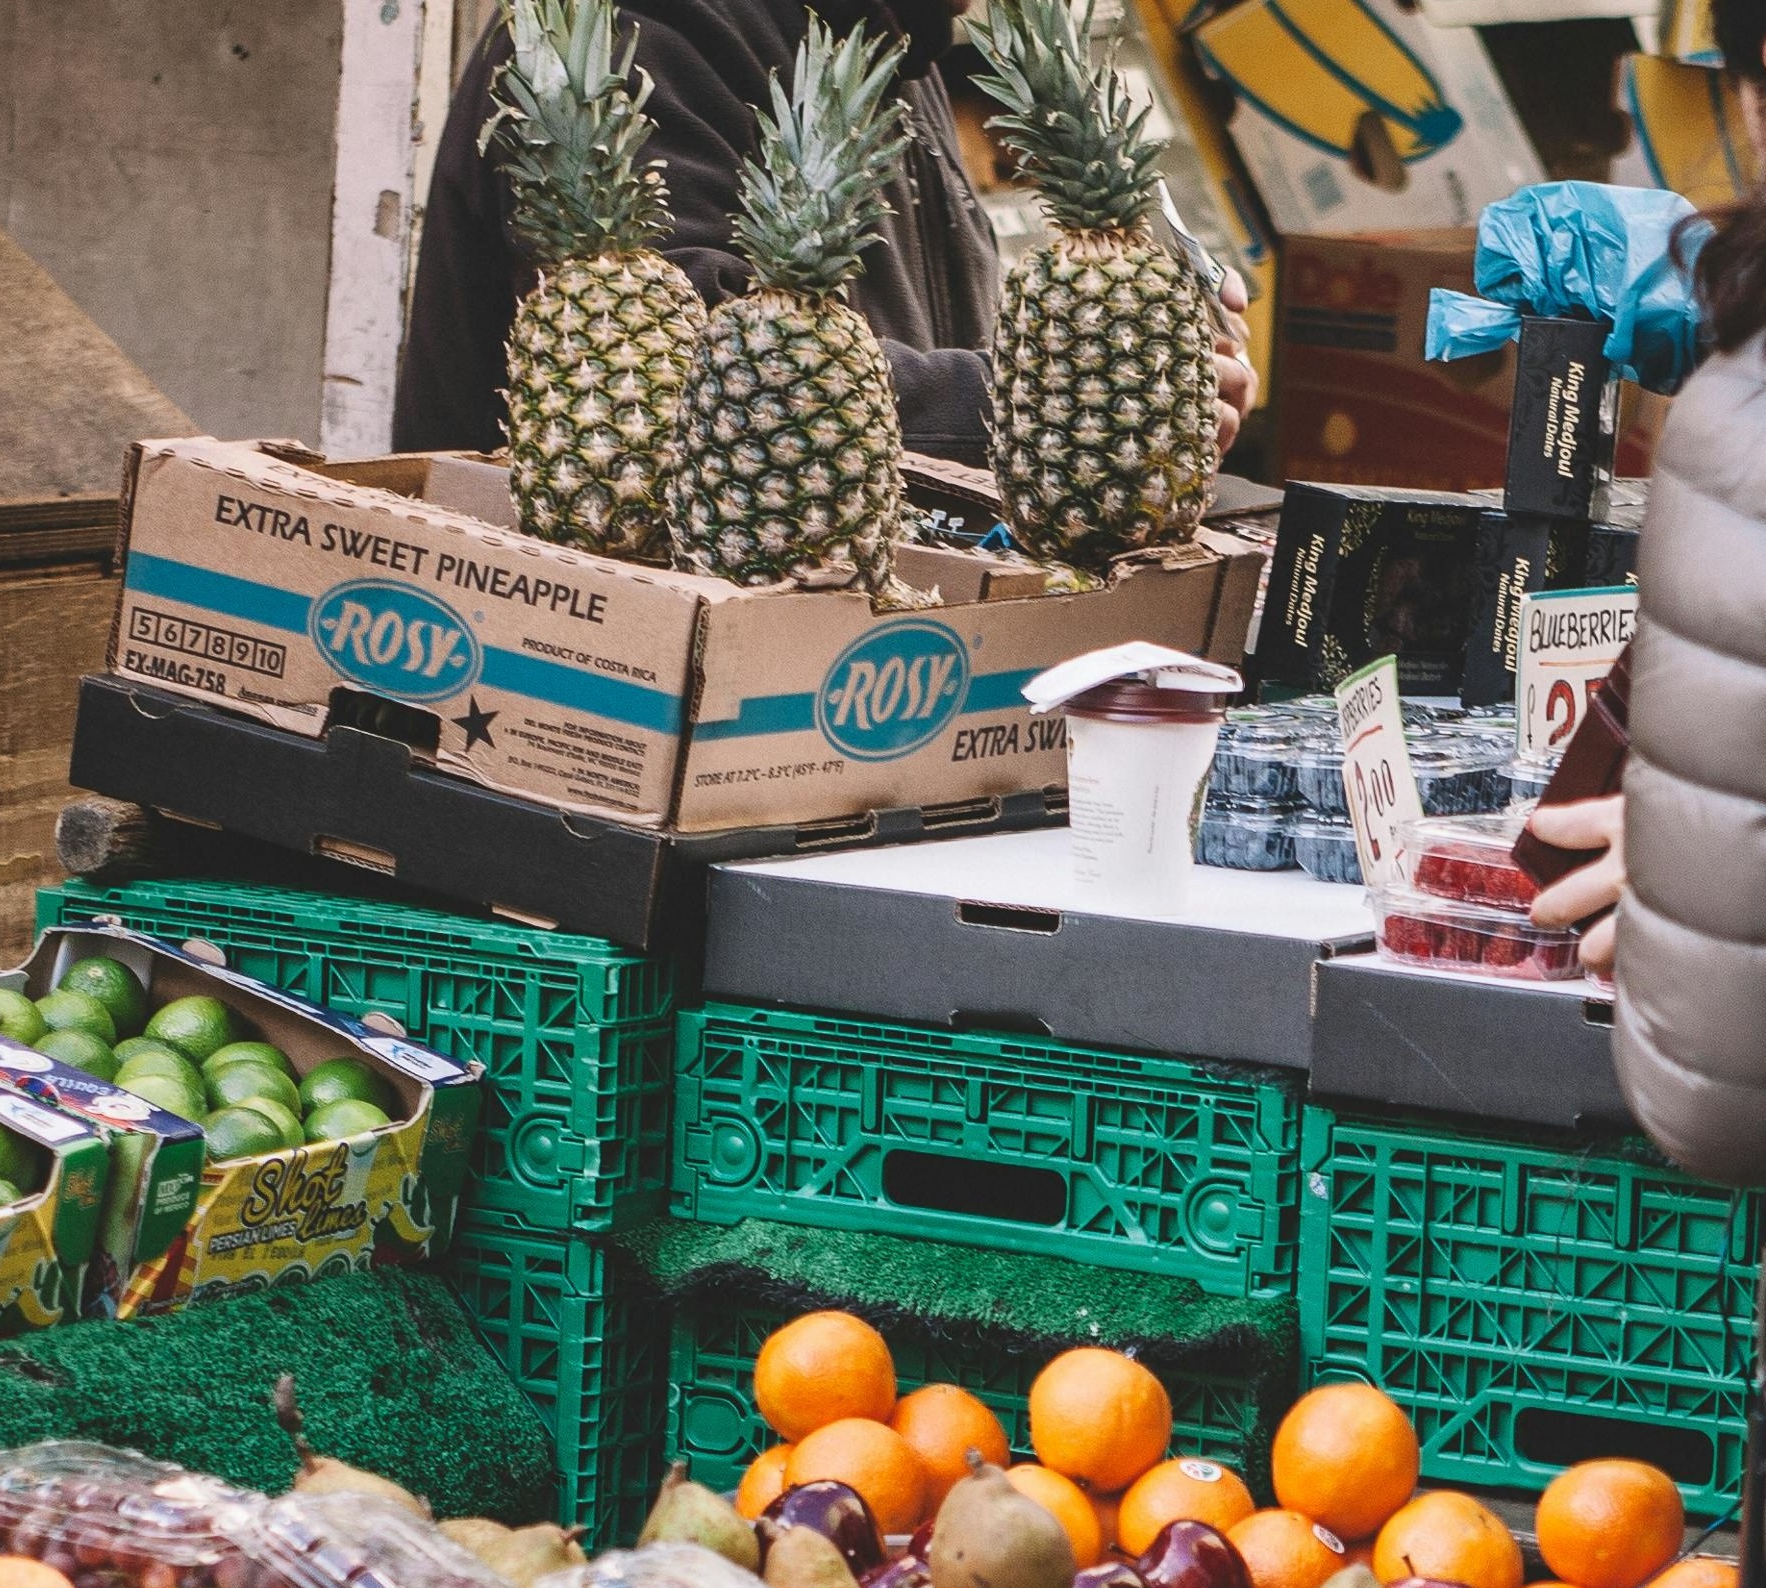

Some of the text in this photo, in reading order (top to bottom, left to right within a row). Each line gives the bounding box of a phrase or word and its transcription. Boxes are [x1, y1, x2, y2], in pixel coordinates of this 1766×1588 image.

[1543, 376, 1563, 458] Natural Dates
[1557, 361, 1585, 478] King Medjoul
[215, 495, 610, 625] EXTRA SWEET PINEAPPLE
[1509, 557, 1531, 598] King
[1286, 547, 1306, 626] Natural Dates
[1295, 533, 1325, 648] King Medjoul
[138, 615, 151, 635] 5
[164, 623, 178, 642] 6
[1492, 573, 1511, 653] Natural Dates
[190, 627, 203, 648] 7
[212, 636, 226, 655] 8
[236, 642, 250, 661] 9
[260, 647, 281, 671] 10
[332, 600, 462, 679] ROSY
[522, 637, 657, 684] PRODUCT OF COSTA RICA
[124, 649, 227, 695] EX-MAG-758
[833, 654, 957, 731] ROSY
[951, 724, 1019, 762] EXTRA
[240, 1142, 349, 1228] Shot
[210, 1220, 297, 1254] PERSIAN LIMES
